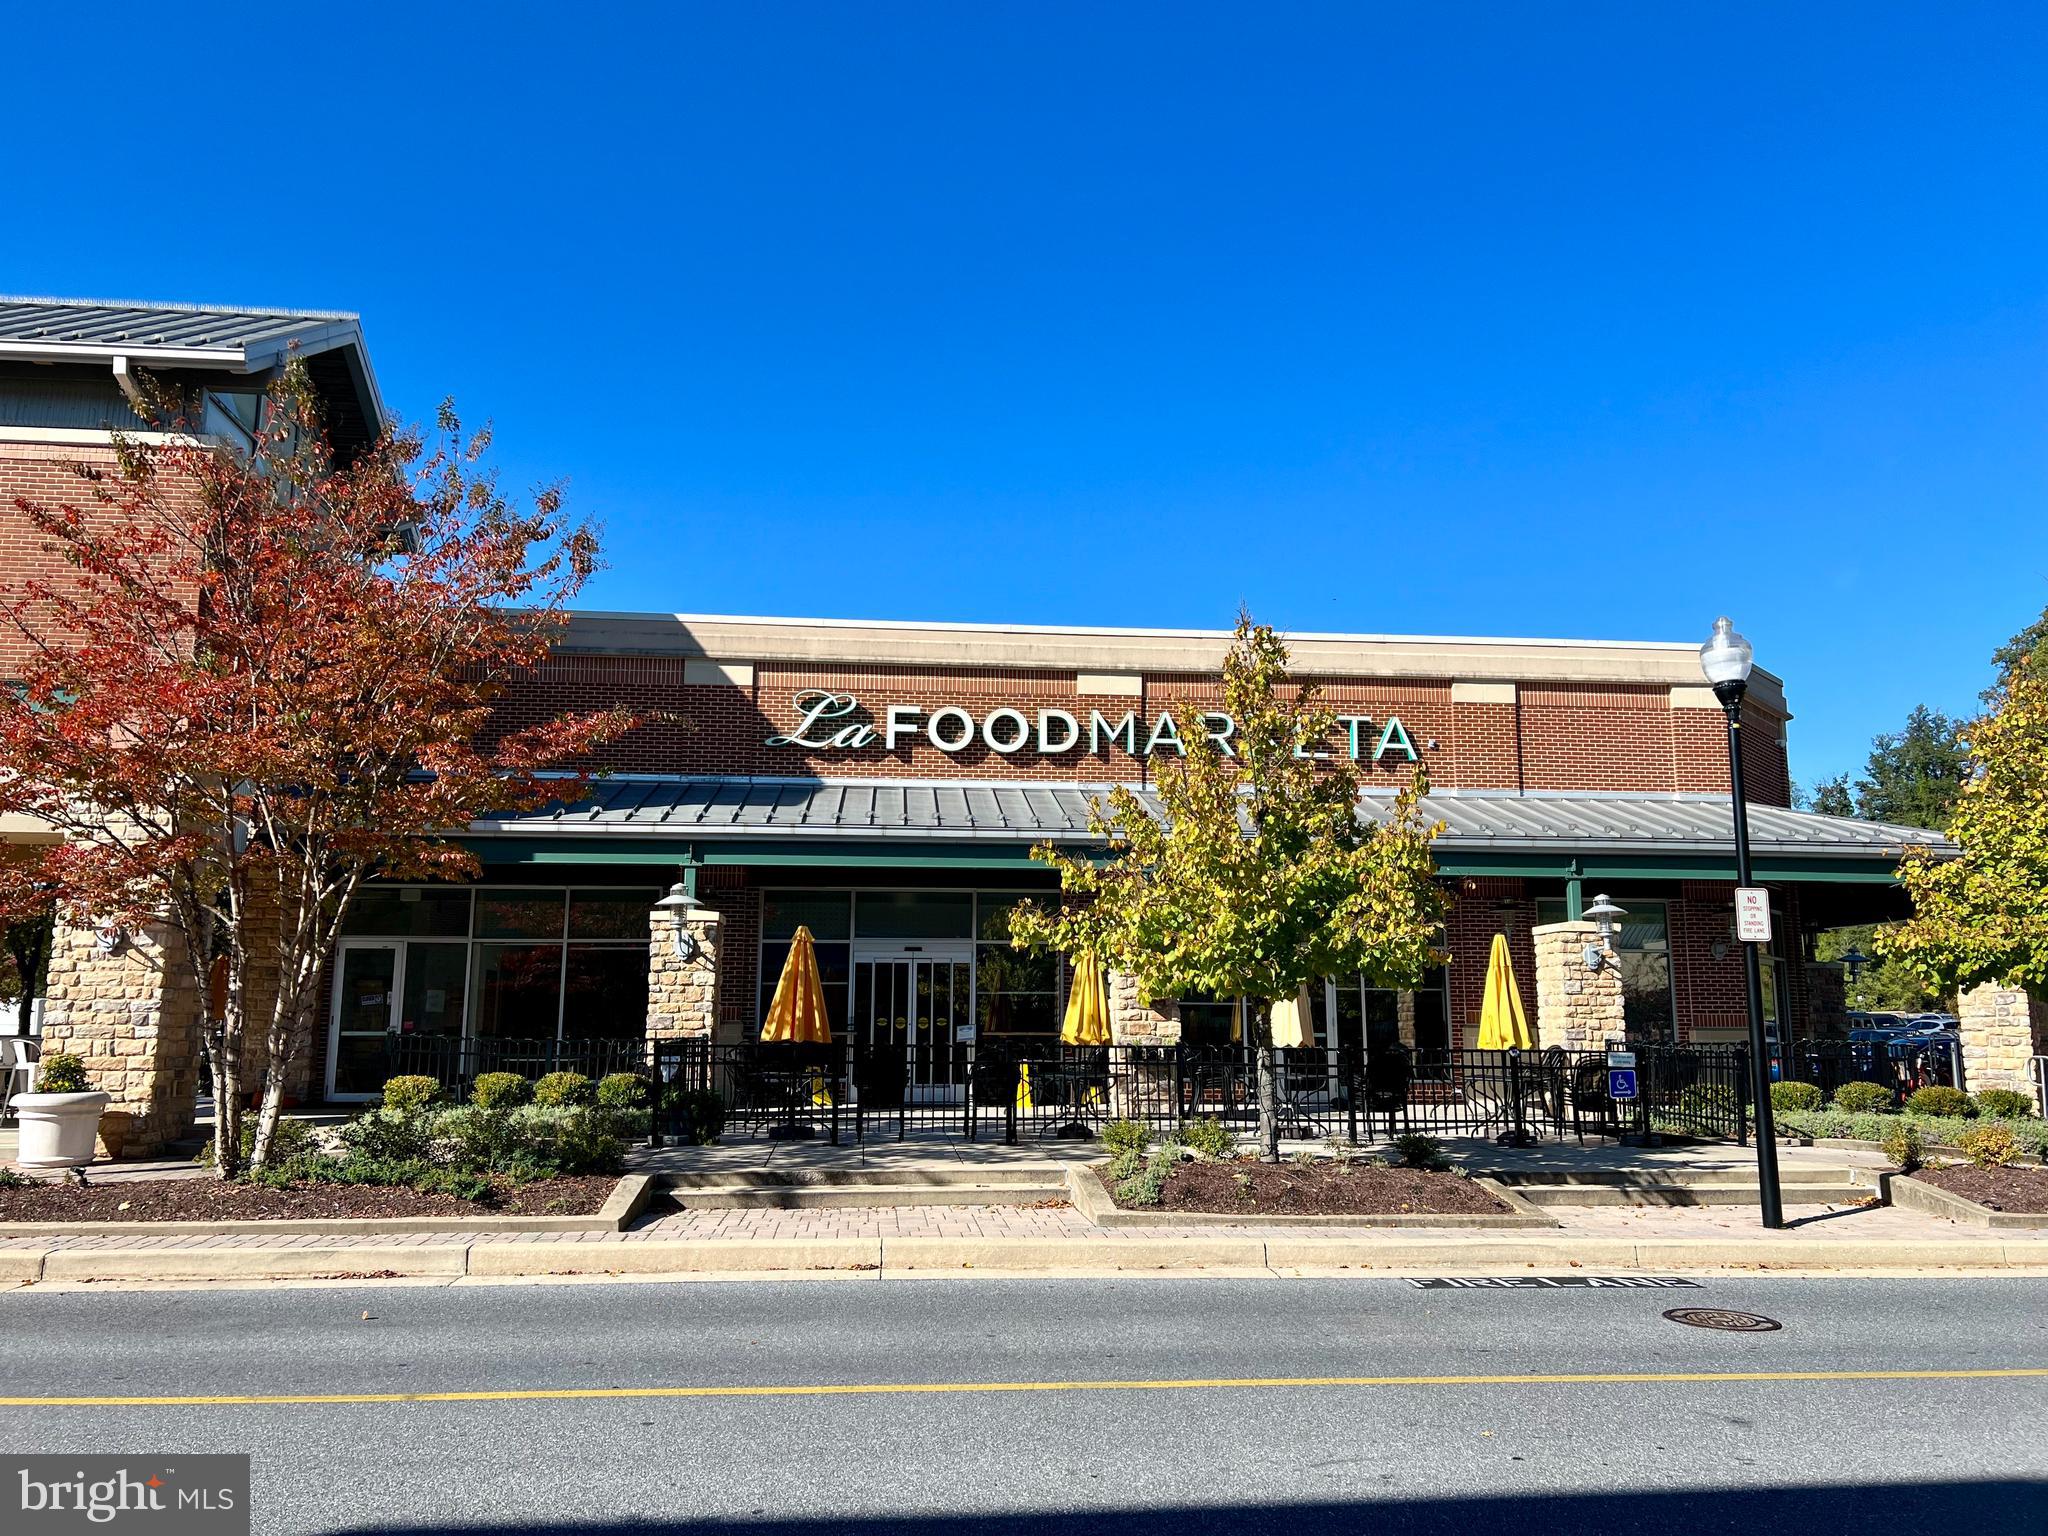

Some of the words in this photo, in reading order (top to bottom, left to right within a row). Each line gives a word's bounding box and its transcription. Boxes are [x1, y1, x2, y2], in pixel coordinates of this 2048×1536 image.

[764, 689, 877, 748] La
[885, 704, 1418, 761] FOODMARTA
[1747, 896, 1757, 904] NO
[1404, 1278, 1538, 1287] FIRE
[1536, 1278, 1697, 1287] LANE
